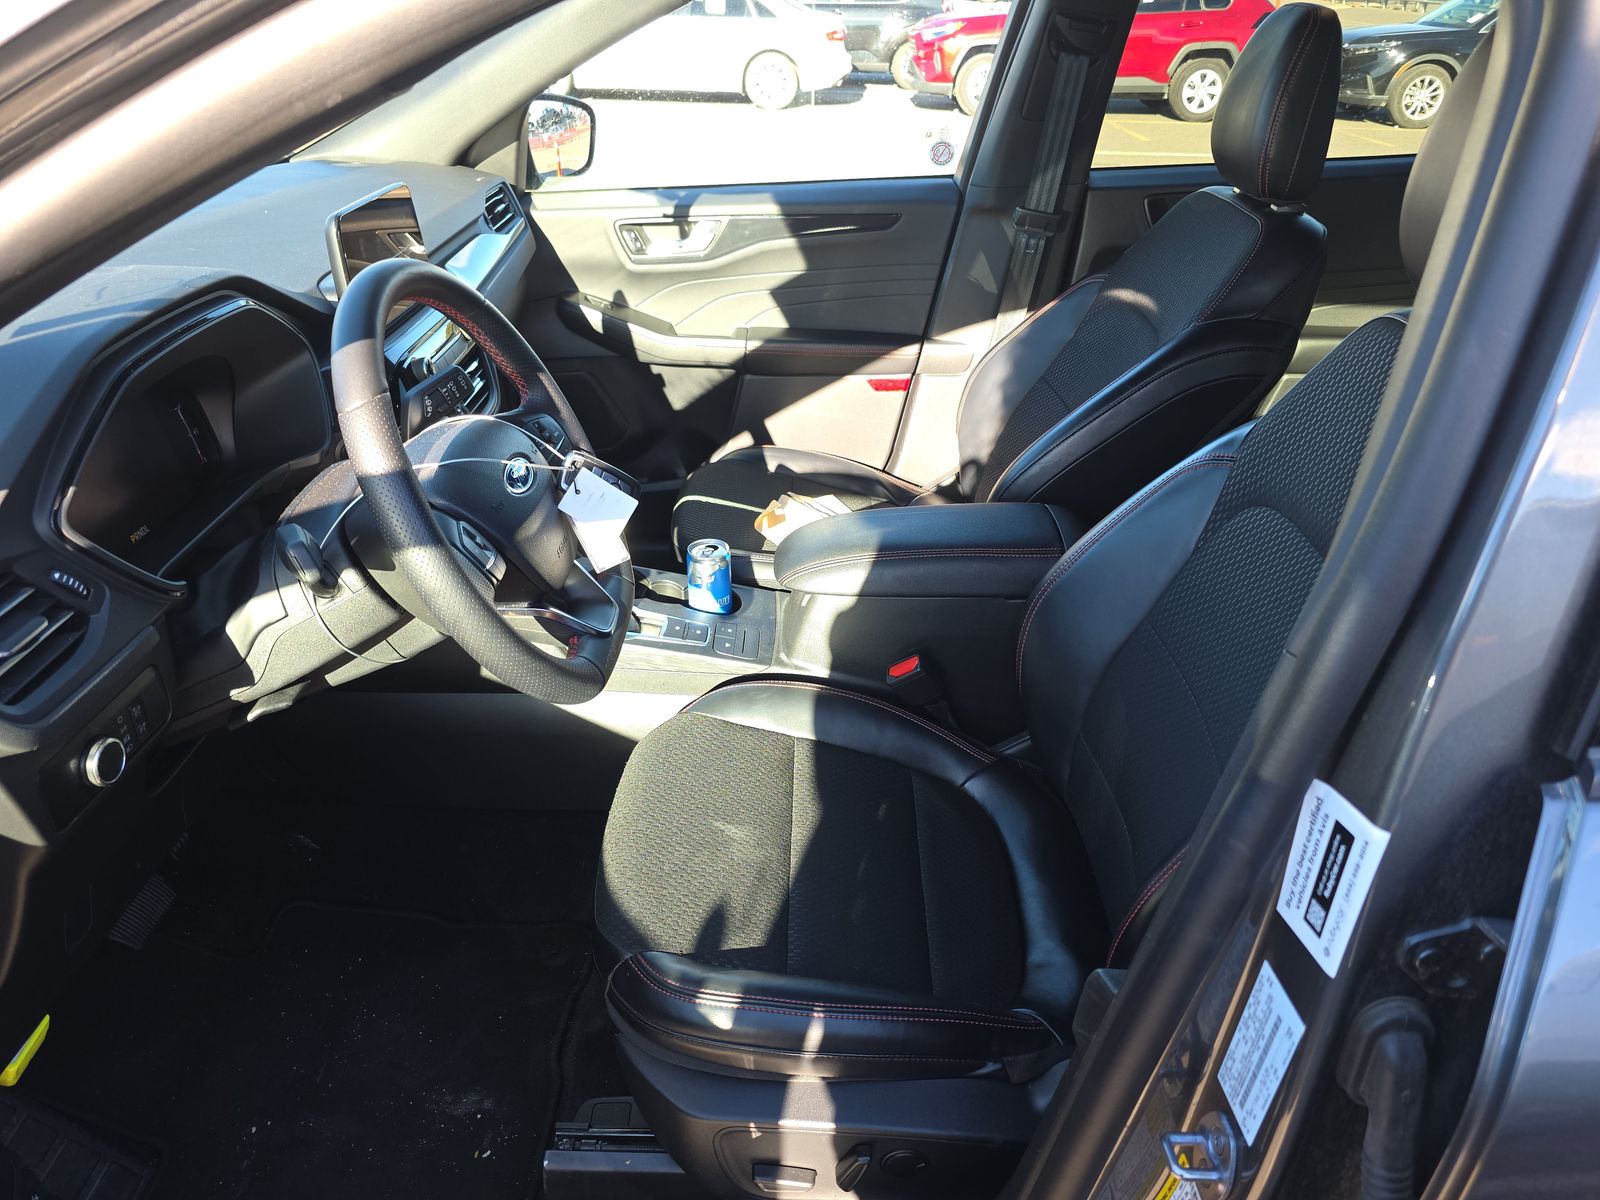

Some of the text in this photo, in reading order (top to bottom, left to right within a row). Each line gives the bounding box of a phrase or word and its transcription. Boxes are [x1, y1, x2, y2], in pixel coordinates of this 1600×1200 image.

[1285, 797, 1324, 909] Buy the best certified
[1295, 866, 1312, 909] vehicles
[1308, 839, 1321, 866] from
[1317, 813, 1329, 837] Avis
